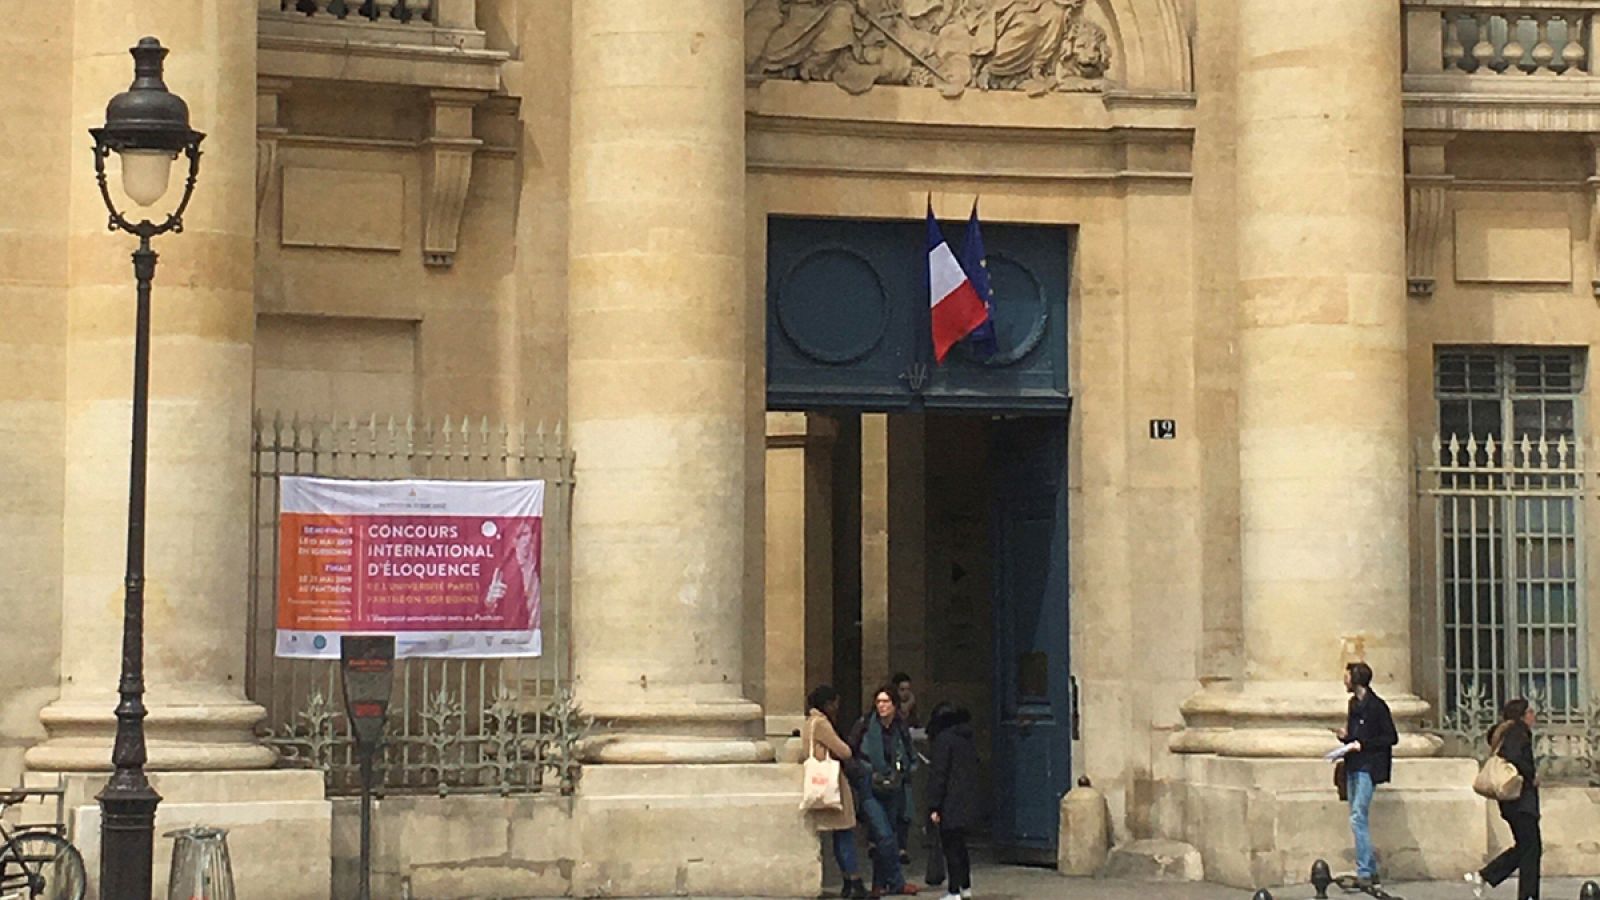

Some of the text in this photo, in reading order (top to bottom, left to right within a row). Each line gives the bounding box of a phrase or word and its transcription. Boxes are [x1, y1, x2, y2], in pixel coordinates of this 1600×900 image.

[1153, 420, 1173, 439] 12
[368, 524, 459, 539] CONCOURS
[368, 544, 495, 558] INTERNATIONAL
[367, 560, 481, 579] D'ÉLOQUENCE
